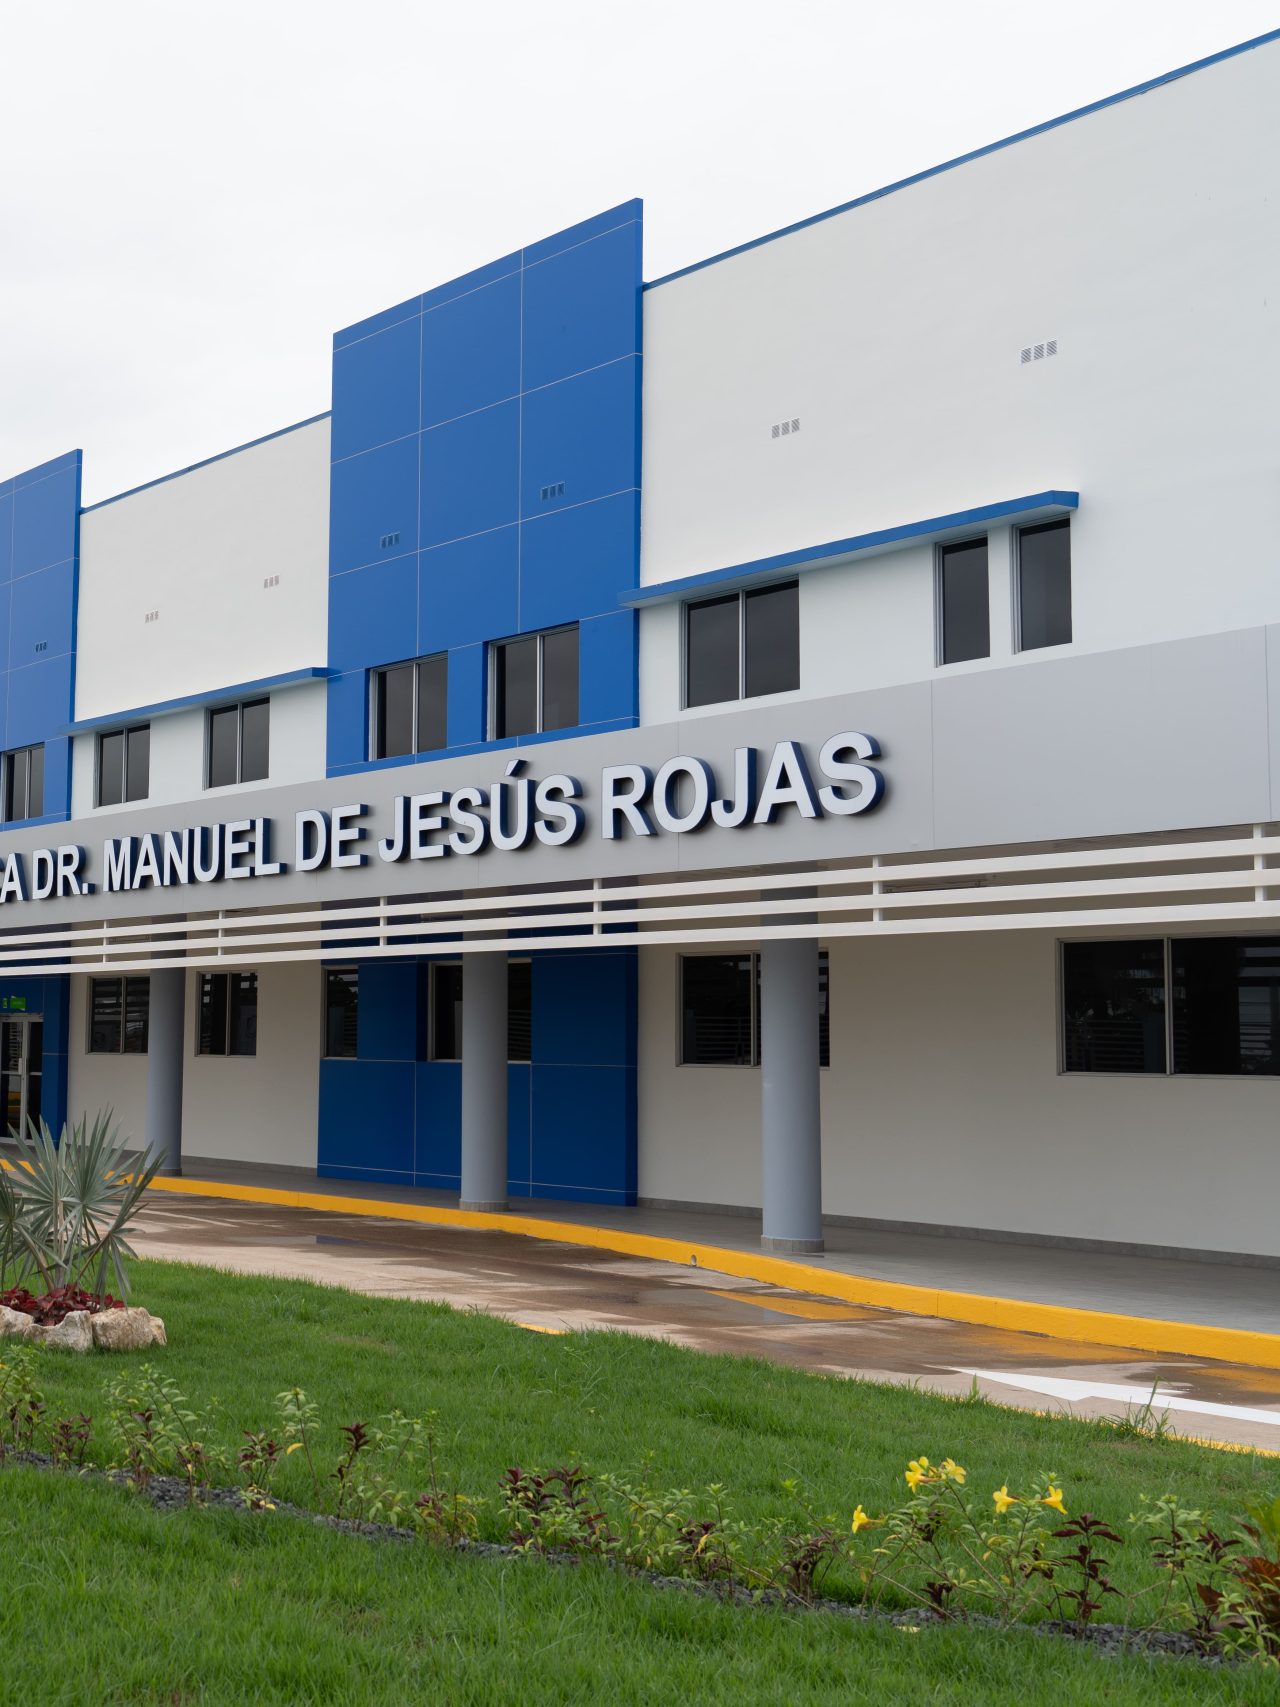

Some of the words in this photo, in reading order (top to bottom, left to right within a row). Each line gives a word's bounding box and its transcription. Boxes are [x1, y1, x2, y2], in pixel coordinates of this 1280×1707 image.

[32, 844, 92, 899] DR.
[103, 816, 285, 892] MANUEL
[295, 803, 366, 874] DE
[378, 758, 583, 863] JESÚS
[601, 730, 881, 841] ROJAS
